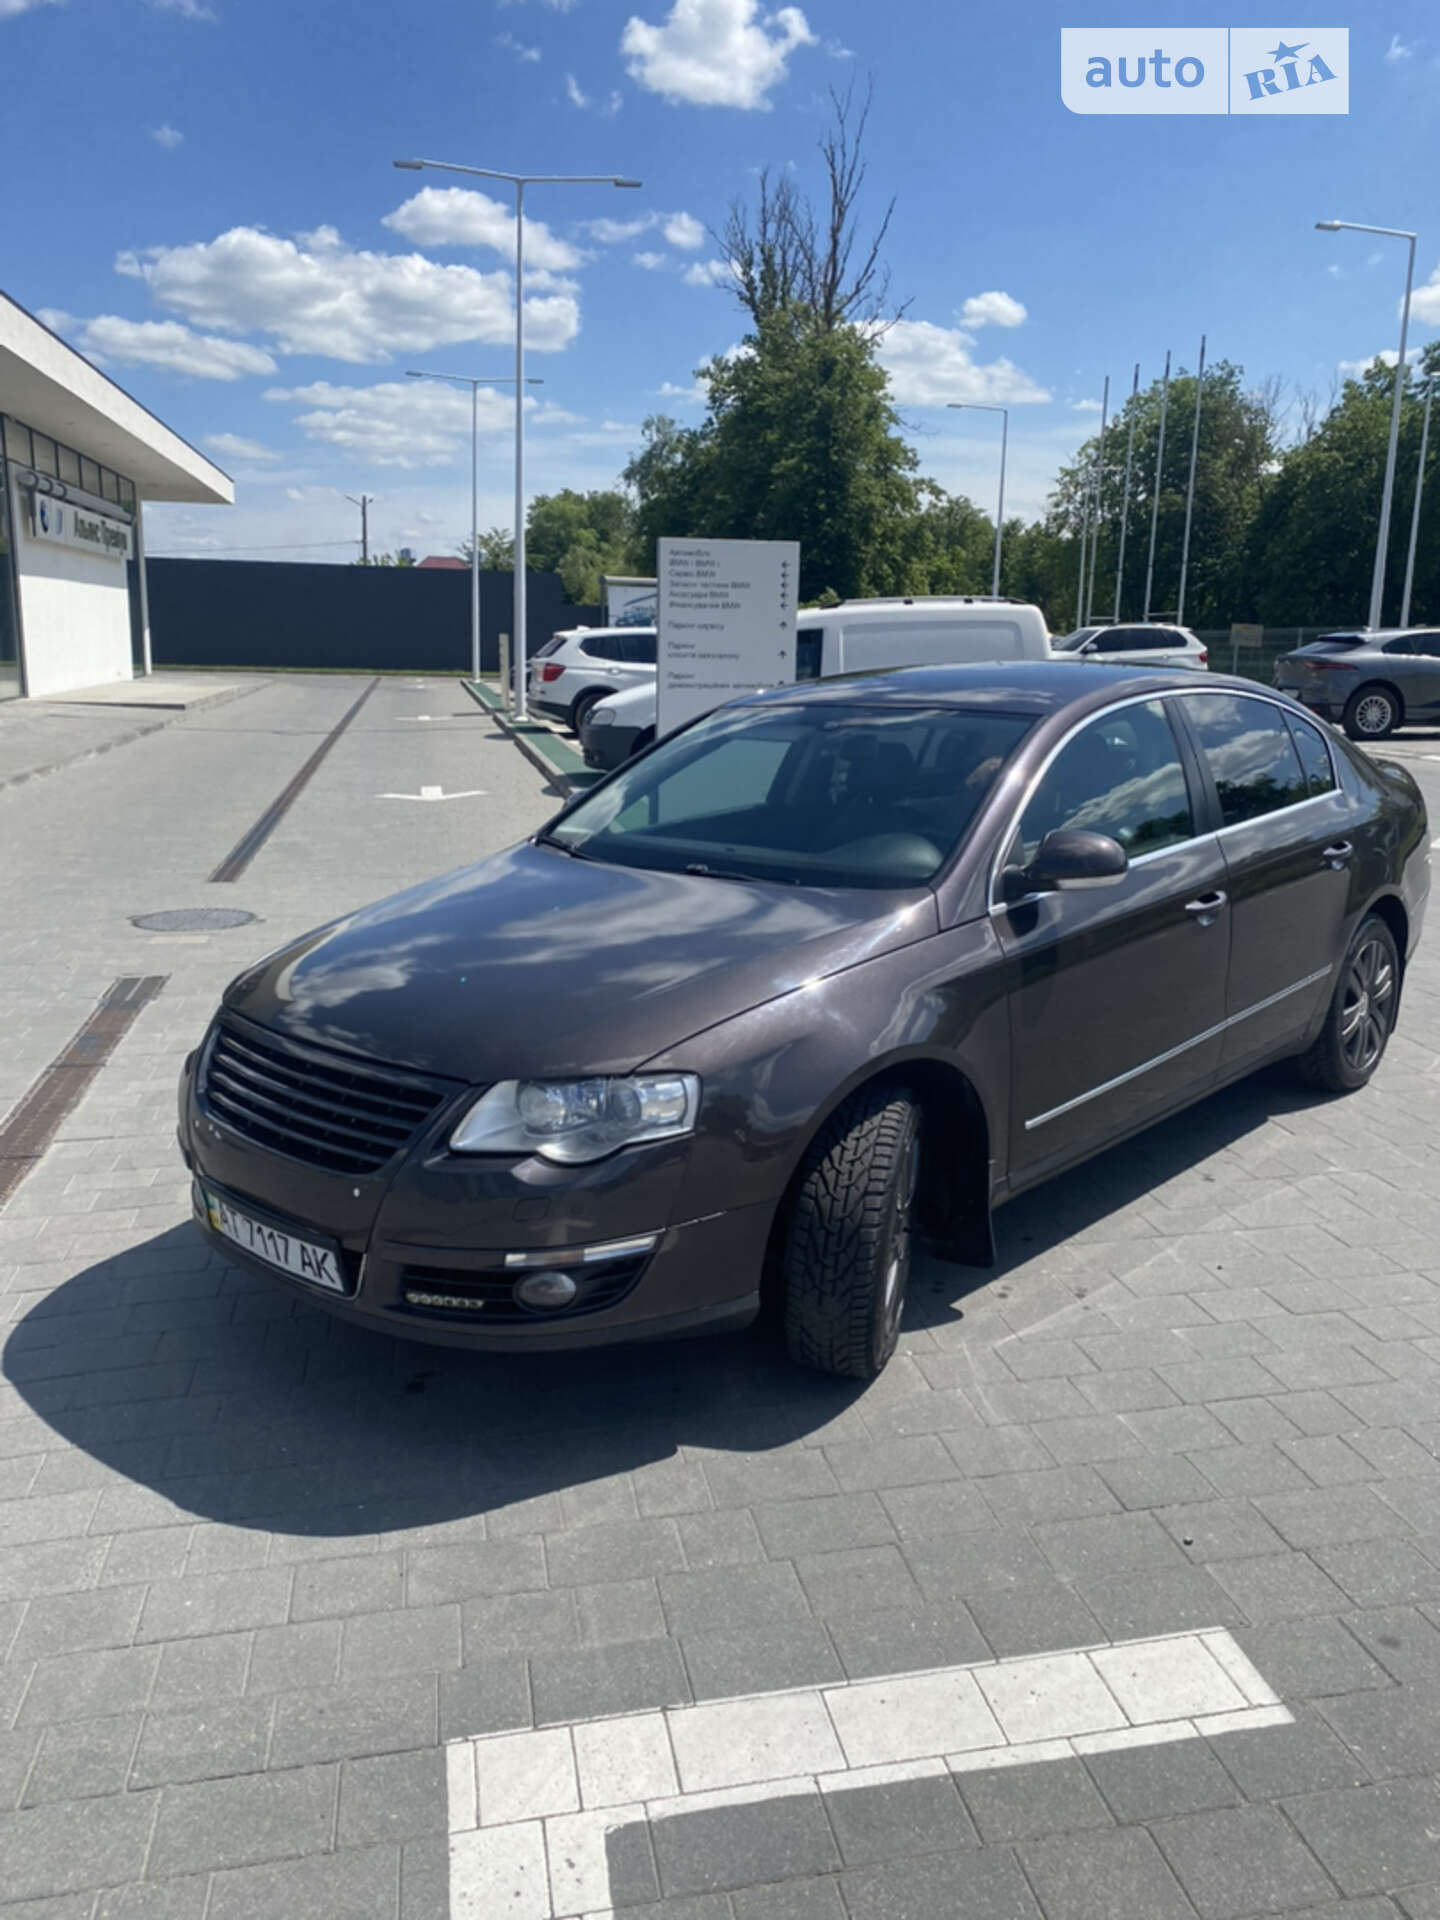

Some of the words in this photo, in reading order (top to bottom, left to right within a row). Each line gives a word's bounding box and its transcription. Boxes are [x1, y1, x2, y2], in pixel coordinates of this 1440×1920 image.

[221, 1203, 240, 1239] AT
[245, 1219, 289, 1265] 7117
[300, 1243, 336, 1284] AK
